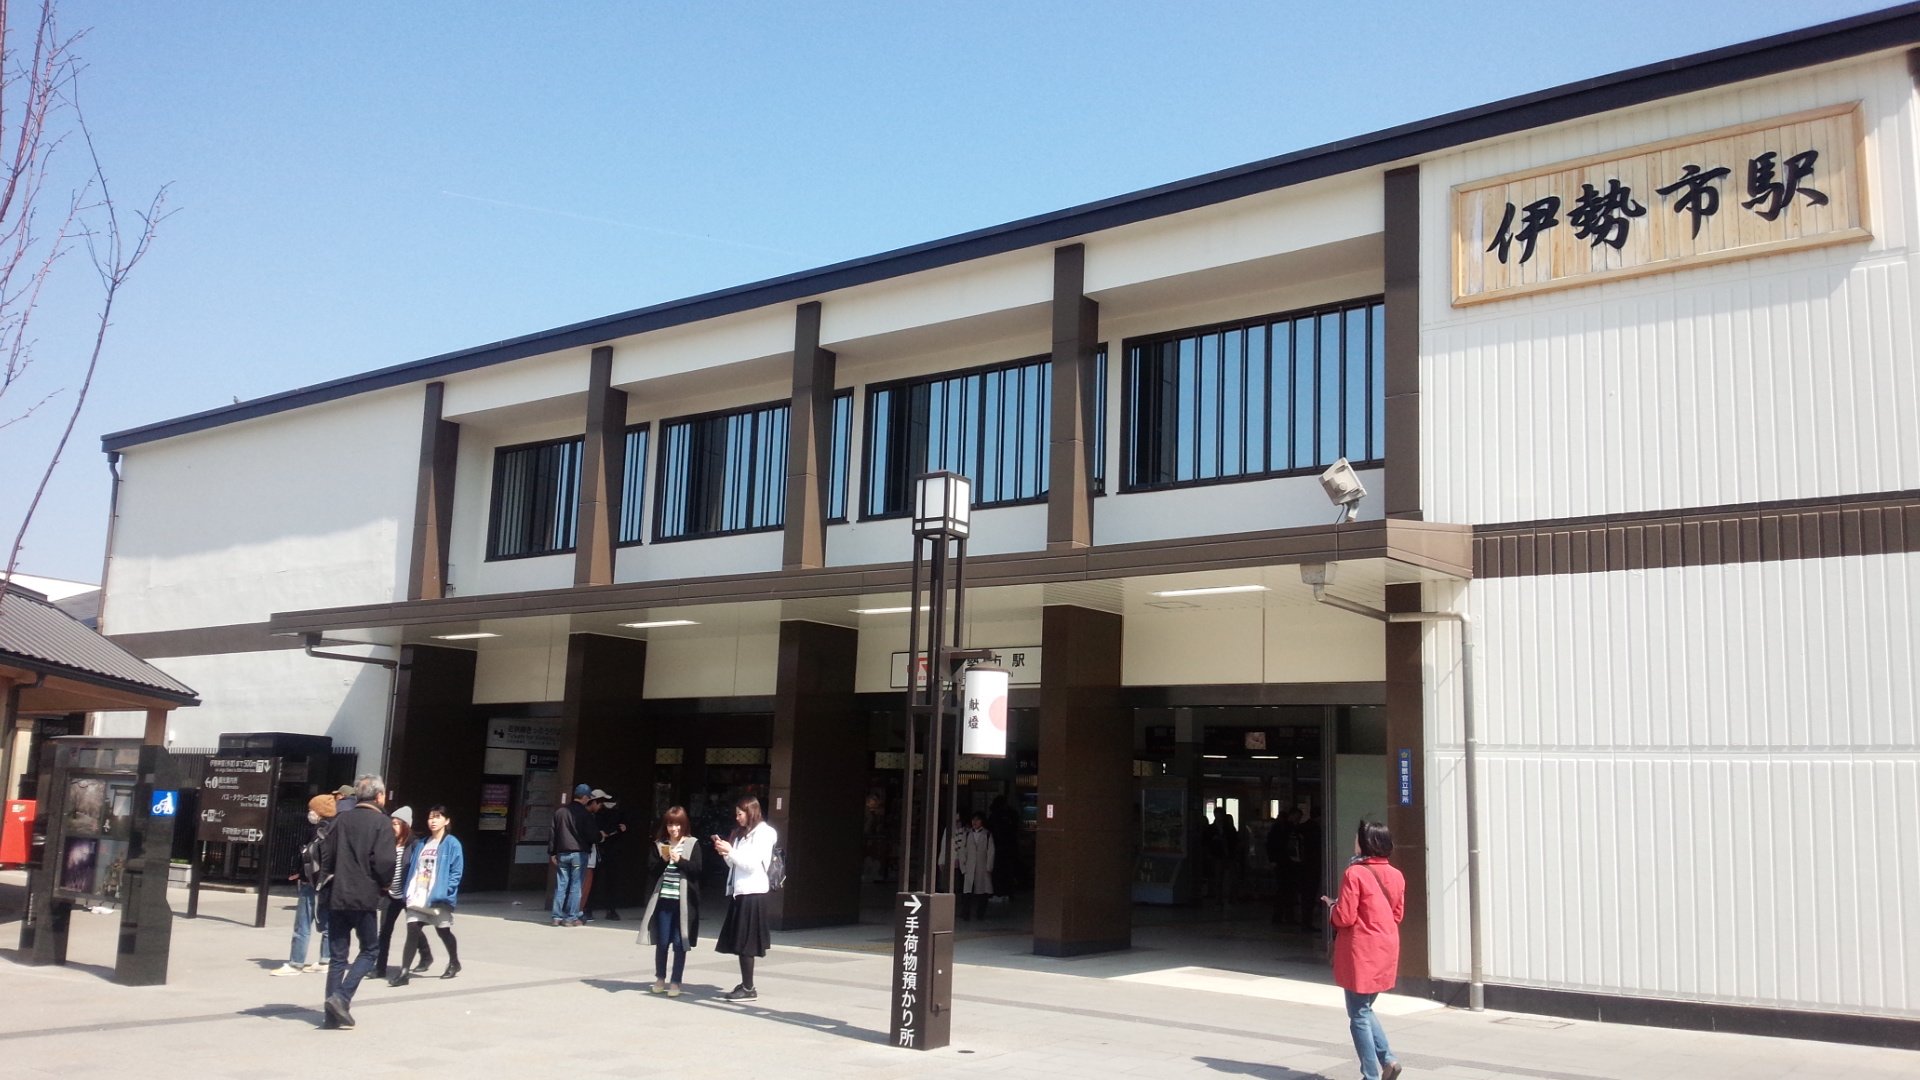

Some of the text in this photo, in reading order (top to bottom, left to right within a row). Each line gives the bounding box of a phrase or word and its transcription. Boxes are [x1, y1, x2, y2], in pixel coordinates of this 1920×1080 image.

[1485, 149, 1830, 265] 伊勢市駅
[898, 916, 920, 1048] 手荷物預かり所
